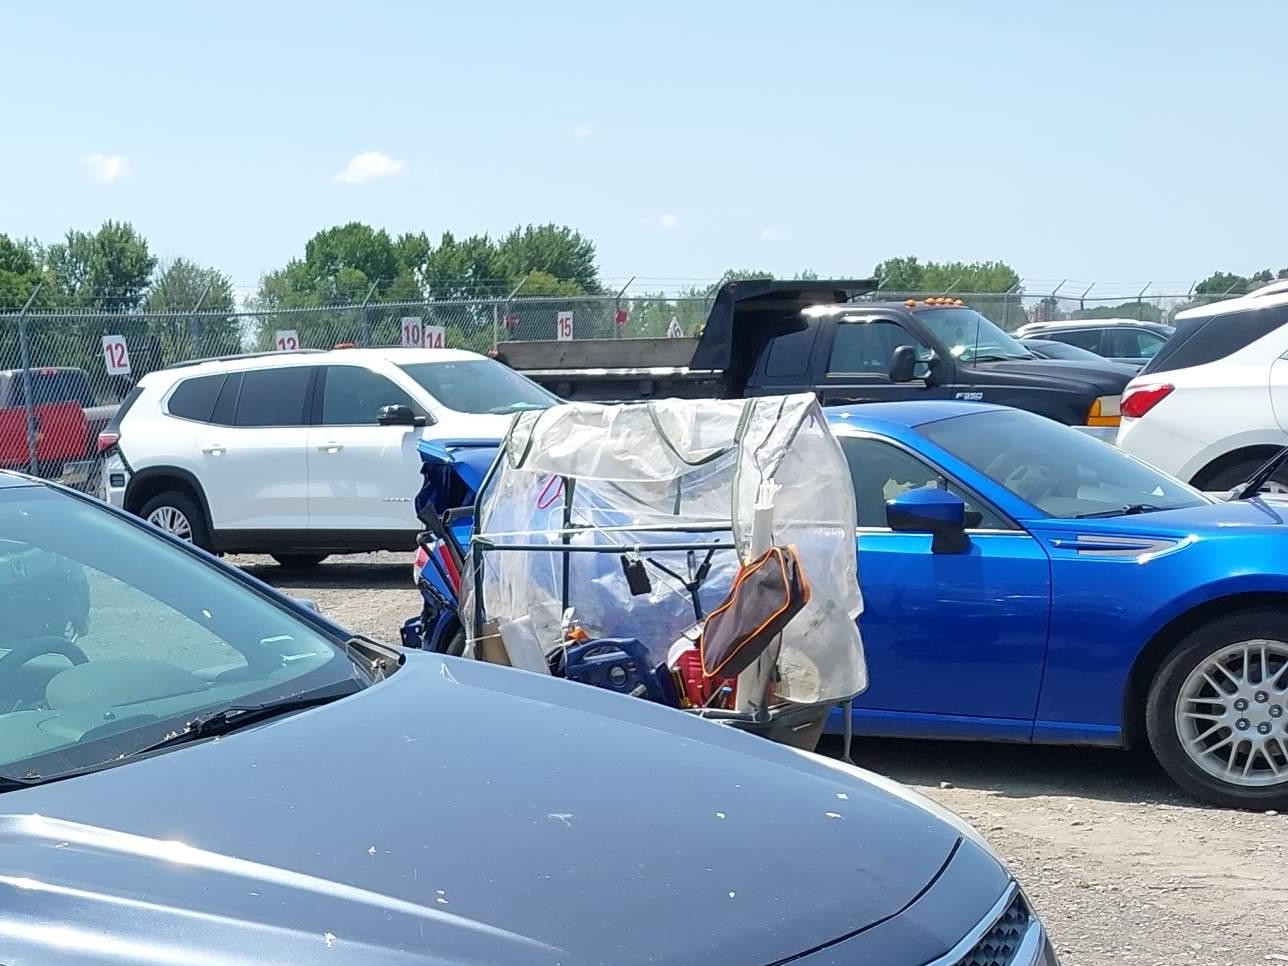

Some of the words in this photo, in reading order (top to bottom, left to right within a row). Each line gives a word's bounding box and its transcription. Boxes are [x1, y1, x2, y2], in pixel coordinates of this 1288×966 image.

[403, 324, 420, 345] 10
[559, 317, 572, 338] 15
[105, 343, 128, 368] 12
